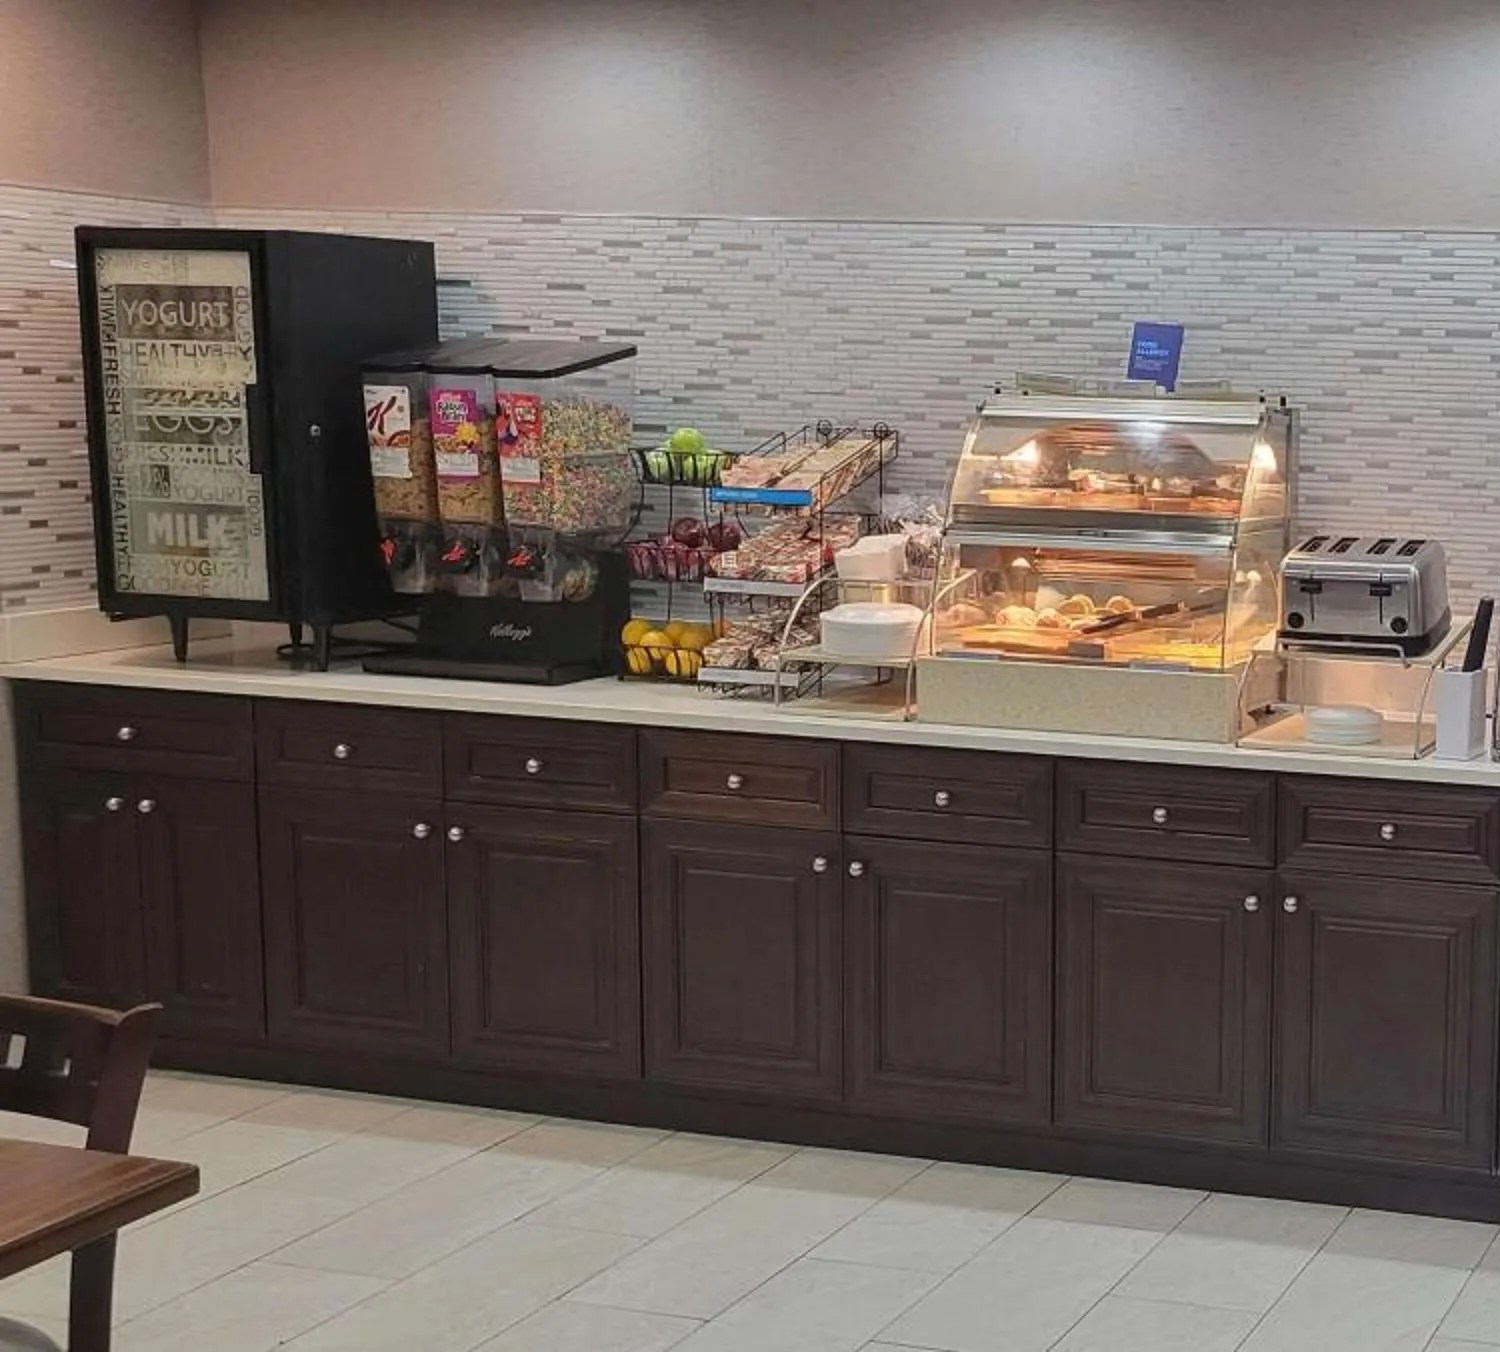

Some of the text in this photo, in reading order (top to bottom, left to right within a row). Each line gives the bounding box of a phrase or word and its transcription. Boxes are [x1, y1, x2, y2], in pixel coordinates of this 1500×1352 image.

[121, 298, 229, 327] YOGURT
[104, 346, 121, 415] FRESH
[146, 511, 230, 549] MILK
